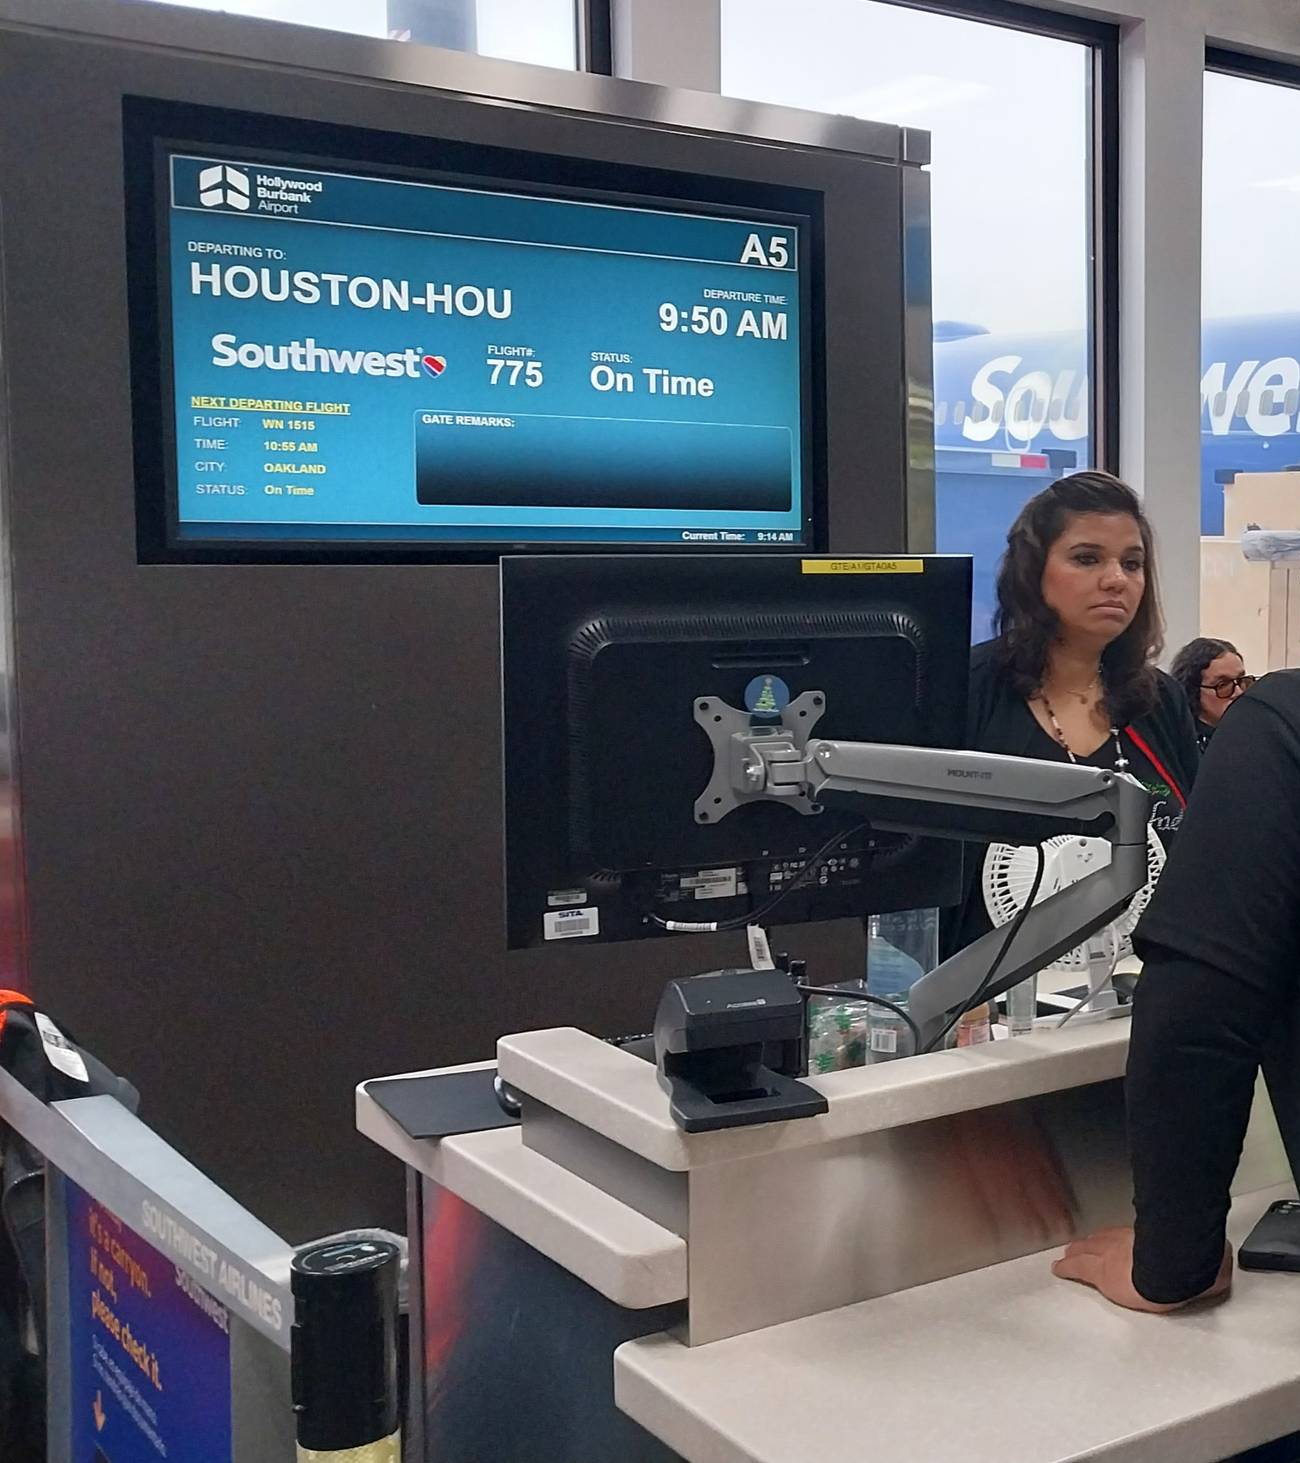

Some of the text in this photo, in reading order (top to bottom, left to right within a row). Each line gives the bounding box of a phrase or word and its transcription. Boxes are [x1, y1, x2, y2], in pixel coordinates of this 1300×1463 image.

[256, 174, 323, 193] Hollywood
[256, 188, 312, 204] Burbank
[257, 200, 300, 215] Airport
[187, 241, 287, 261] DEPARTING TO:
[739, 233, 789, 268] A5
[190, 261, 513, 320] HOUSTON-HOU
[703, 288, 762, 304] DEPARTURE
[659, 302, 788, 341] 9:50 AM
[211, 332, 421, 379] Southwest
[487, 345, 536, 359] FLIGHT#:
[590, 352, 633, 364] STATUS:
[486, 359, 544, 388] 775
[590, 365, 714, 398] On Time
[191, 396, 351, 414] NEXT DEPARTING FLIGHT
[262, 418, 316, 430] WN 1515
[422, 413, 515, 429] GATE REMARKS:
[263, 441, 318, 453] 10:55 AM
[263, 463, 327, 475] OAKLAND
[264, 484, 315, 496] On Time
[681, 530, 746, 541] Current Time:
[757, 532, 794, 542] 9:14 AM
[141, 1199, 283, 1332] SOUTHWEST AIRLINES
